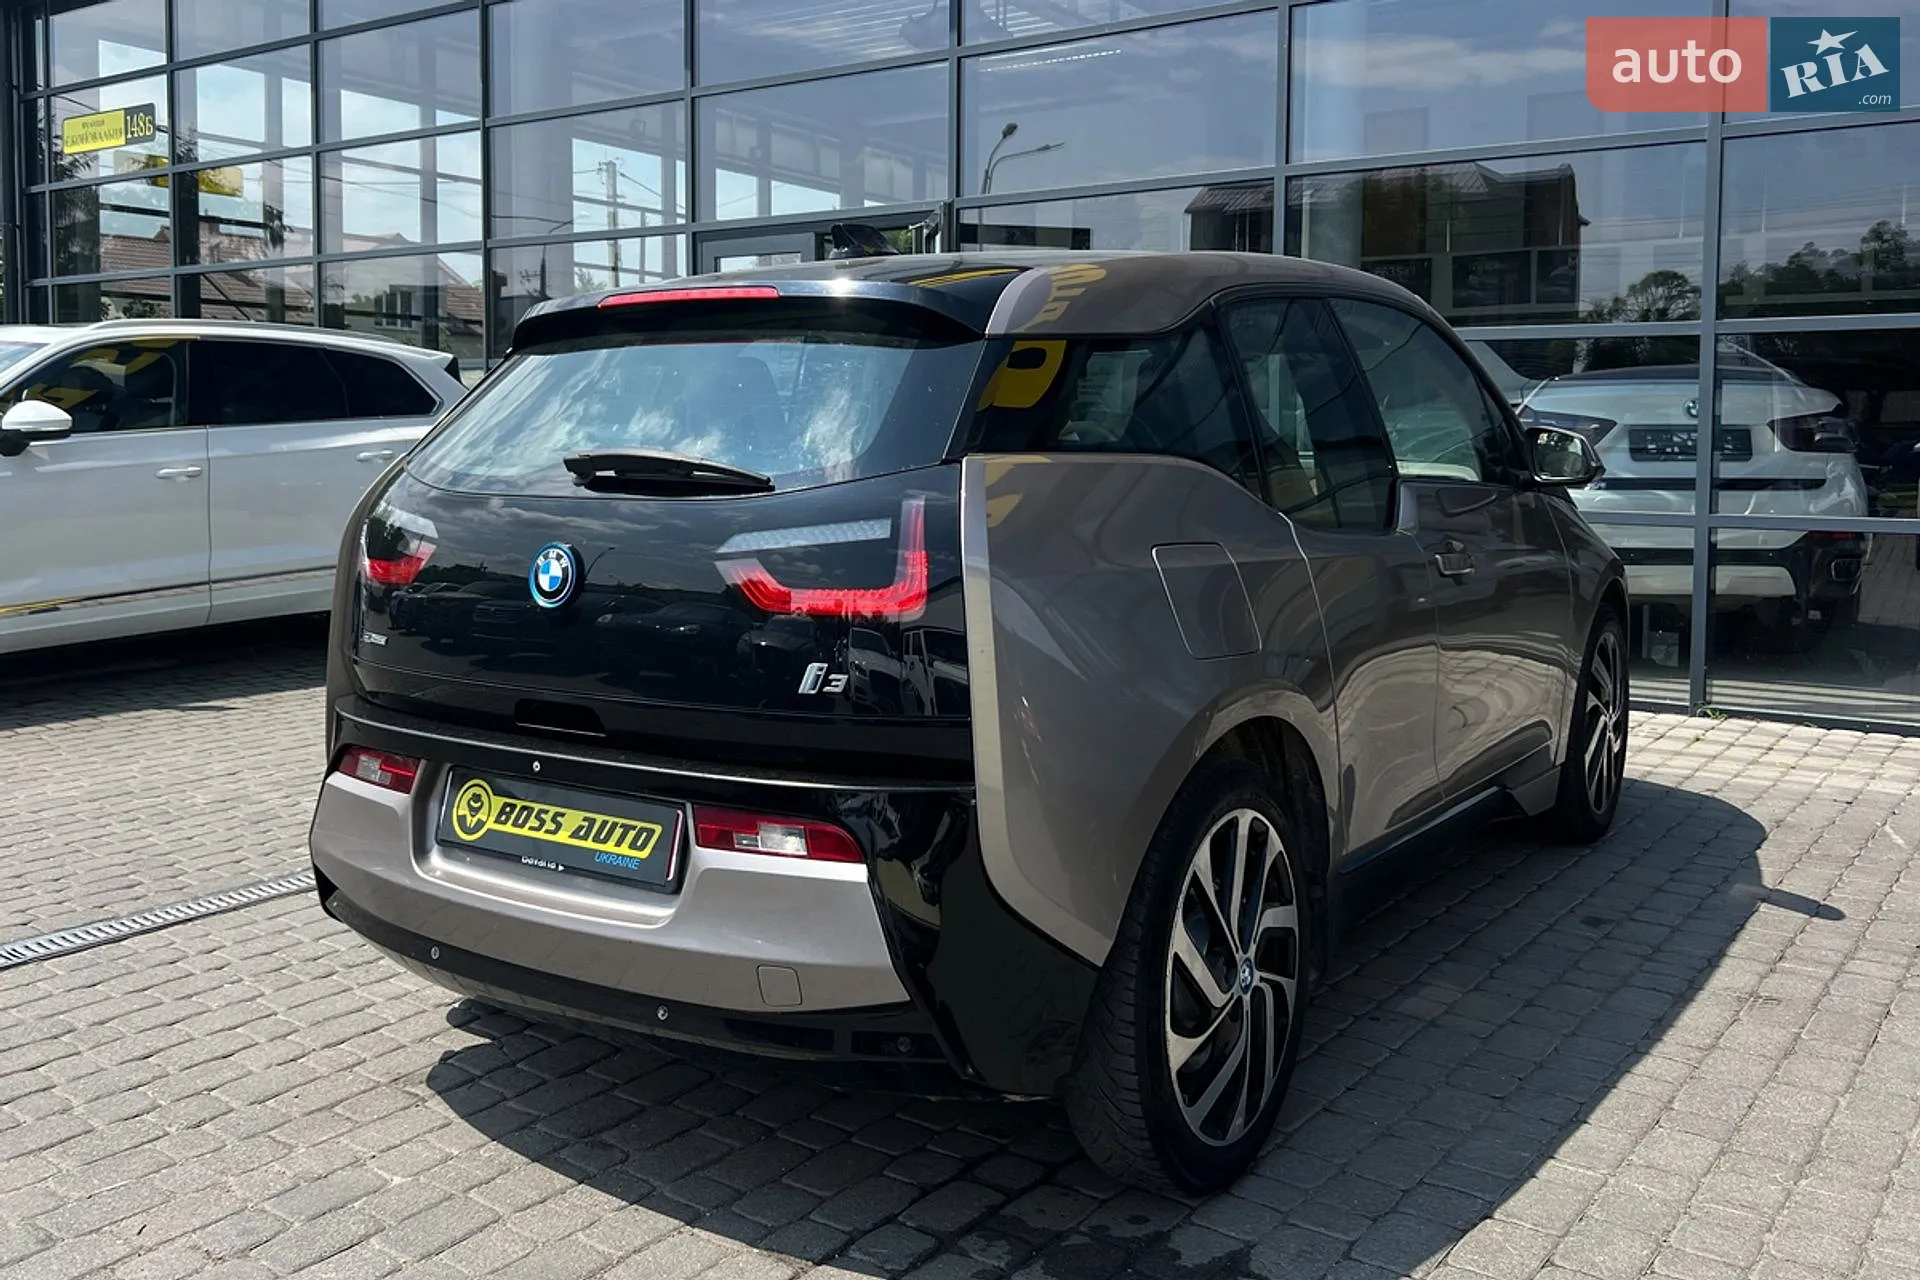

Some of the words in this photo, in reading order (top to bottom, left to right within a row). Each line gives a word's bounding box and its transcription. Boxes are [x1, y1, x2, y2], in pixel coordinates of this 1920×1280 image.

[798, 662, 849, 694] i3
[493, 801, 566, 836] BOSS
[568, 815, 656, 852] AUTO
[595, 851, 641, 870] UKRAINE
